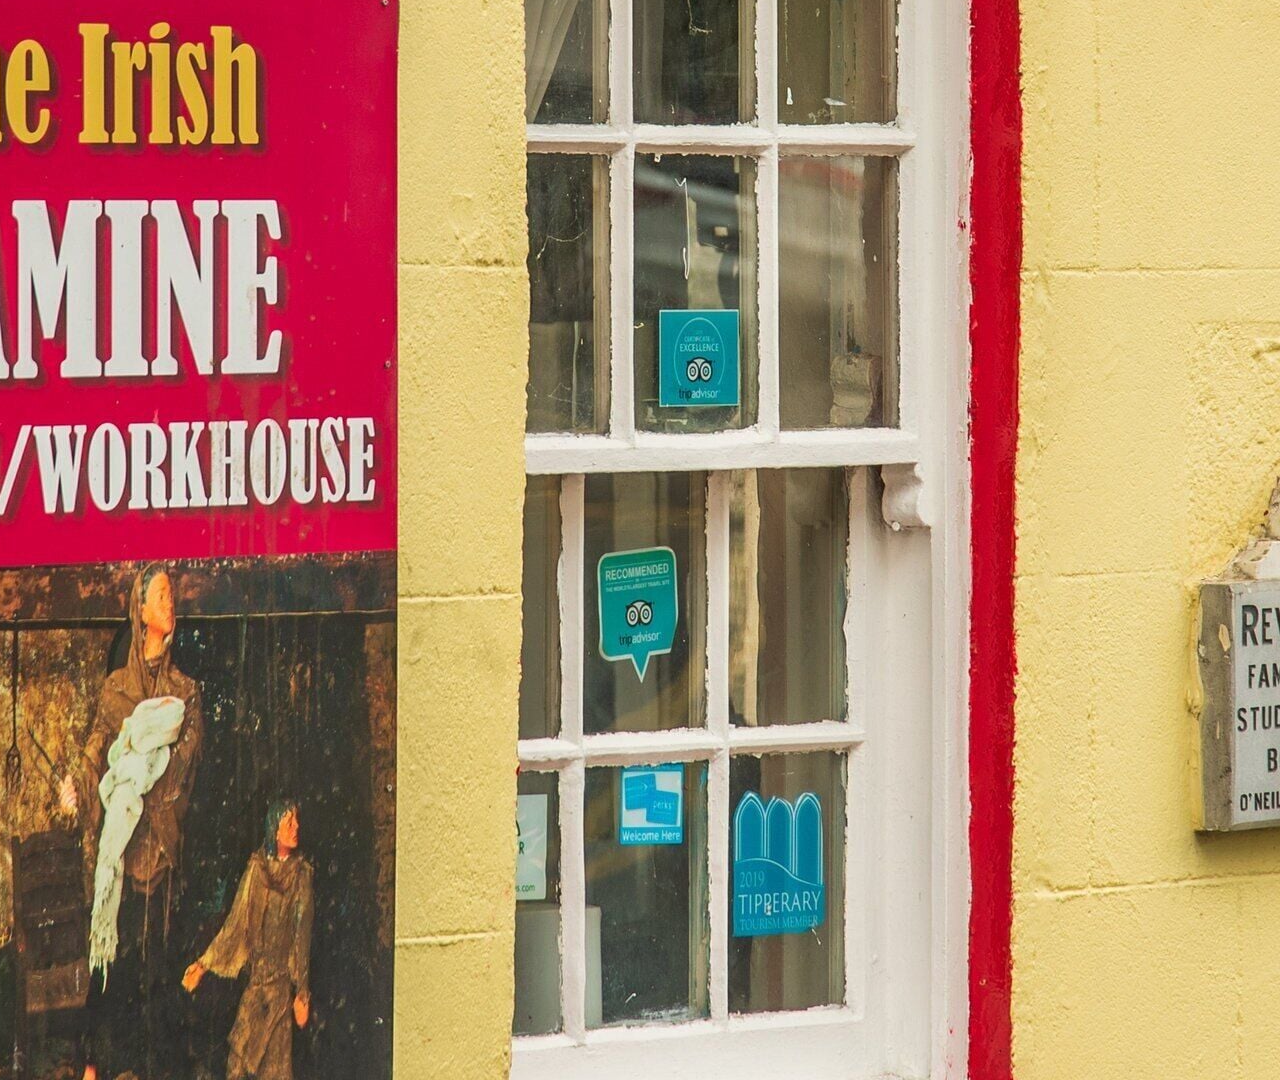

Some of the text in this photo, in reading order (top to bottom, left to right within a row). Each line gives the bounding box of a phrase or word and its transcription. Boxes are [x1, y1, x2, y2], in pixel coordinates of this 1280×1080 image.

[78, 21, 260, 145] Irish
[680, 343, 719, 352] EXCELLENCE
[679, 387, 719, 401] tripadvisor
[605, 563, 669, 581] RECOMMENDED
[619, 630, 659, 647] tripadvisor
[623, 829, 681, 841] Welcome Here
[740, 871, 765, 888] 2019
[738, 891, 821, 915] TIPPERARY
[740, 914, 818, 932] TOURISM MEMBER
